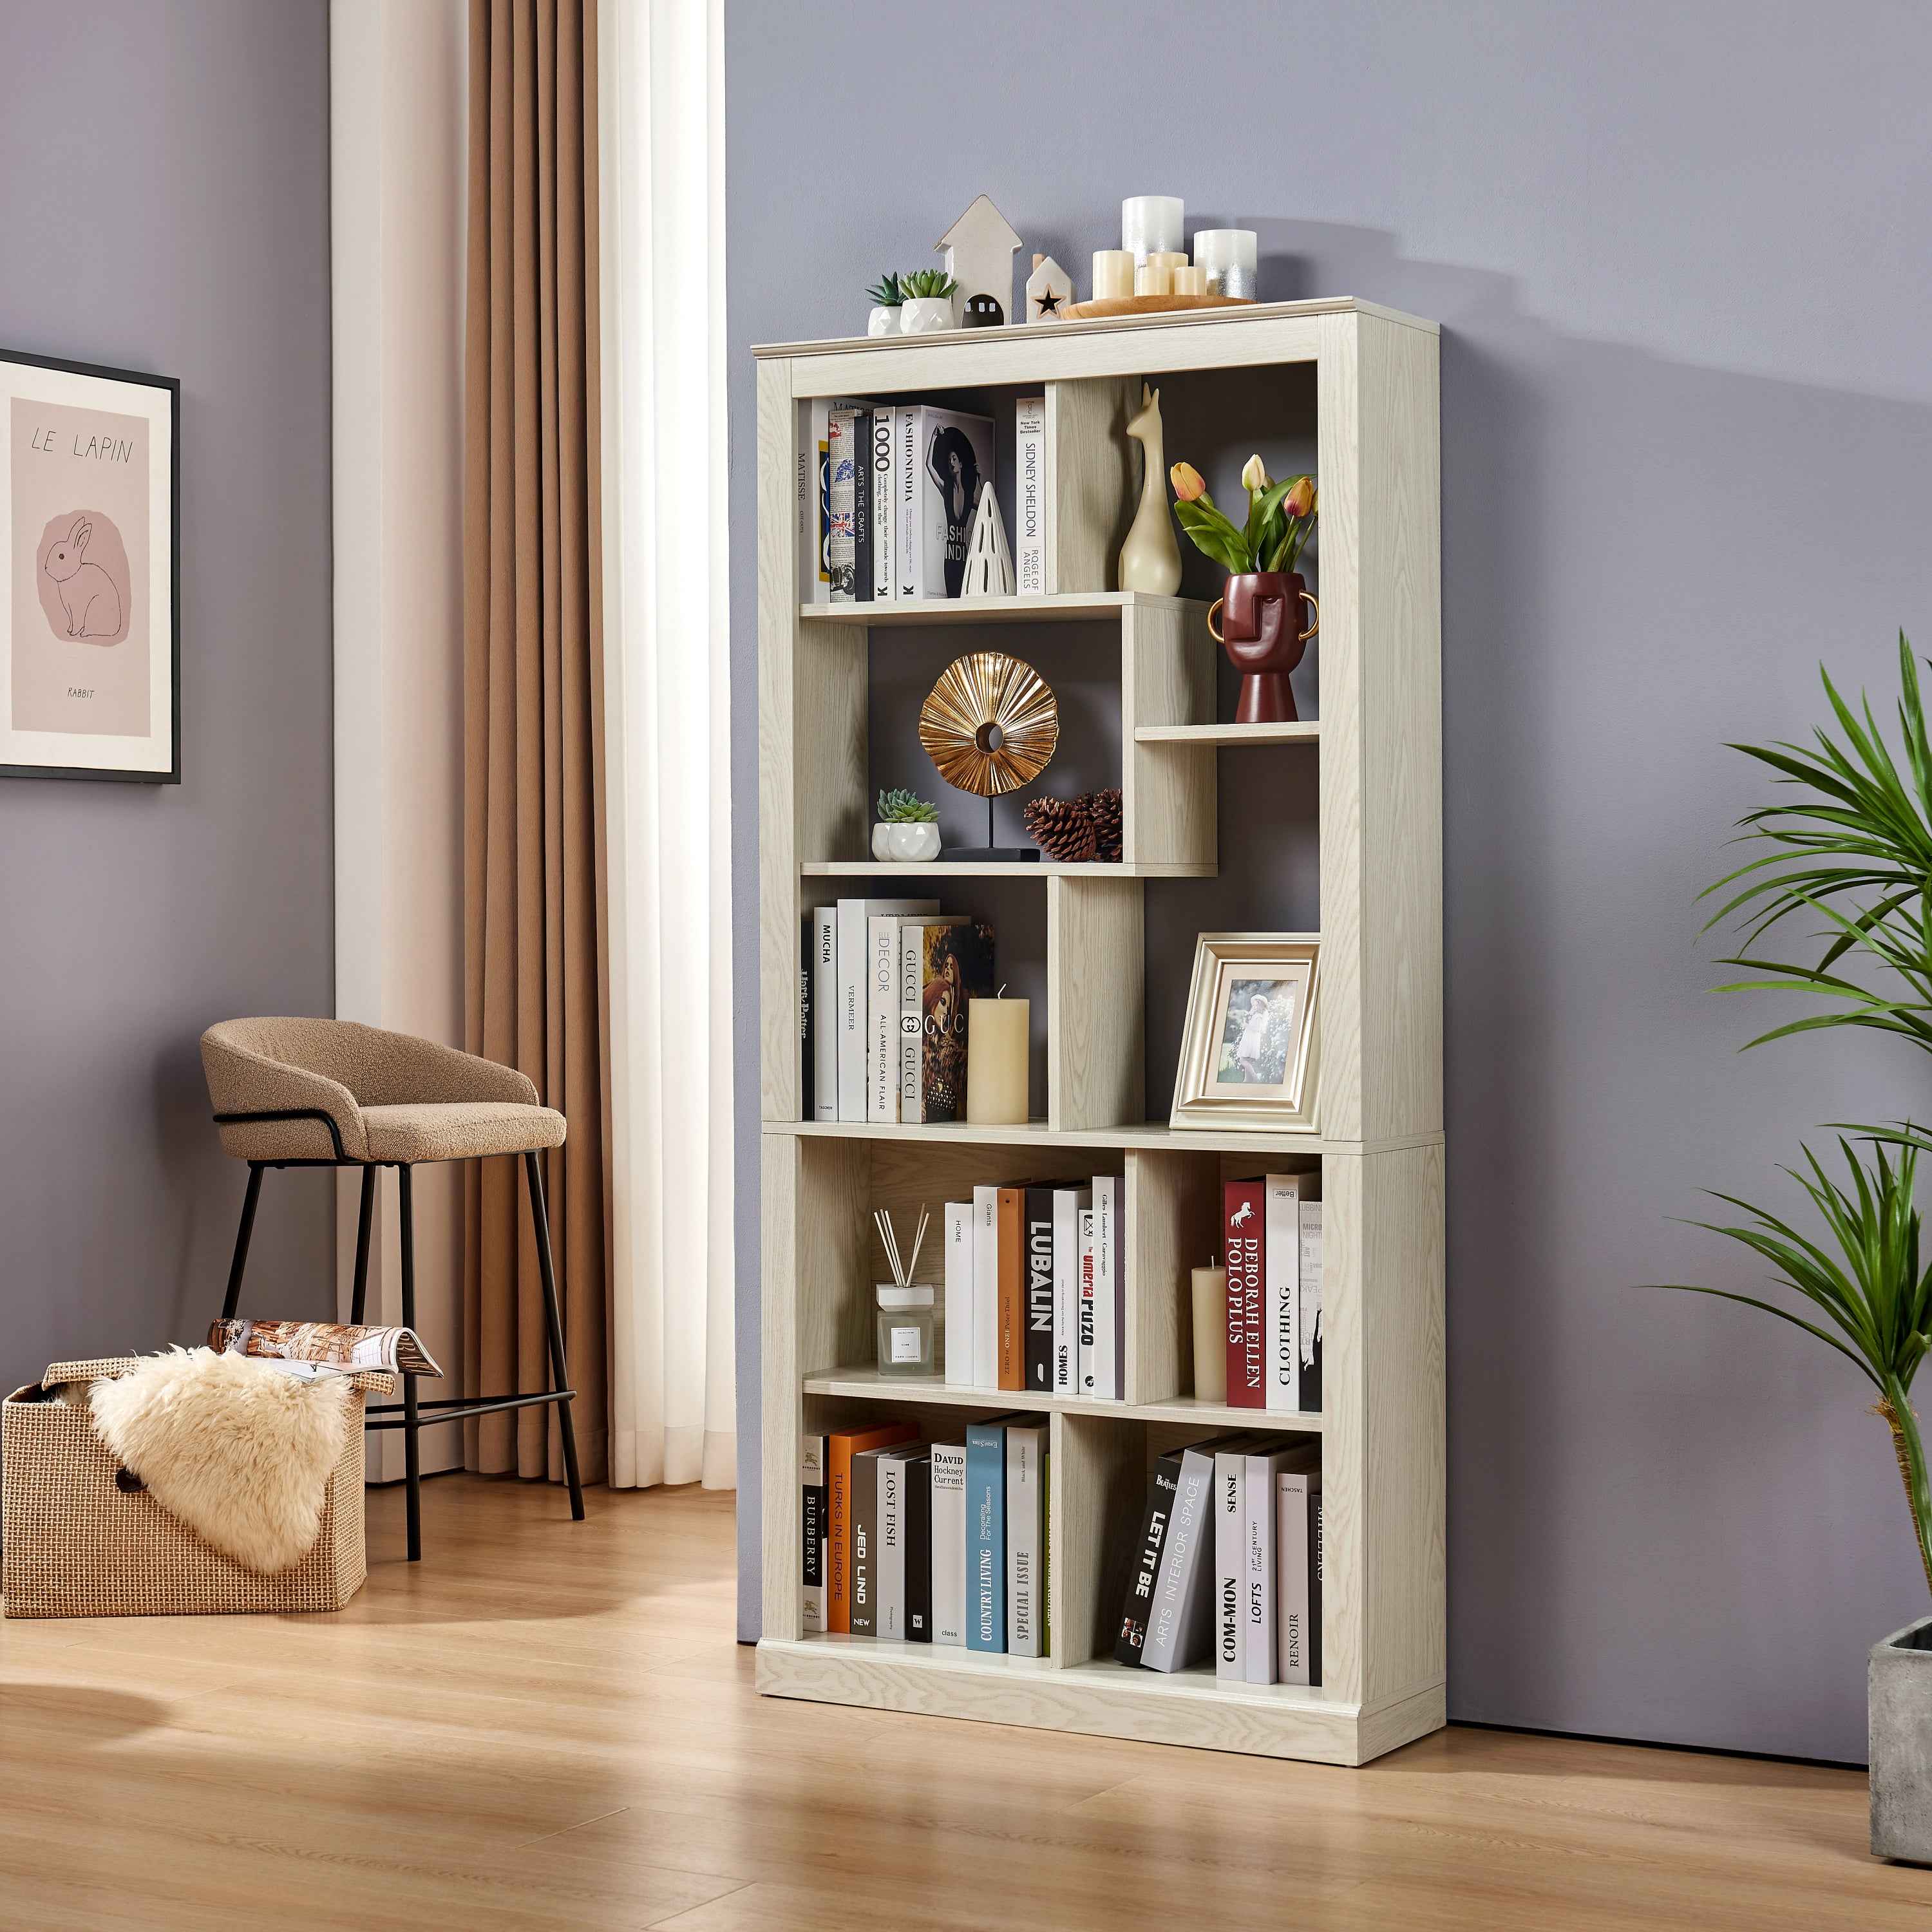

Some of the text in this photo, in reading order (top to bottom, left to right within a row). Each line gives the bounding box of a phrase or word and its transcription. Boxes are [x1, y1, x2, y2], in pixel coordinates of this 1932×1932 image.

[32, 427, 133, 463] LE LAPIN
[875, 415, 890, 472] 1000
[1025, 442, 1036, 537] SIDNEY SHELDON
[945, 544, 968, 562] INDI
[1032, 578, 1039, 591] OF
[67, 687, 95, 699] RABBIT
[878, 938, 889, 992] DECOR
[905, 950, 916, 1003] GUCCI
[905, 1047, 915, 1101] GUCCI
[1030, 1222, 1052, 1331] LUBALIN
[1228, 1238, 1243, 1343] POLO PLUS
[1245, 1238, 1260, 1388] DEBORAH ELLEN
[1279, 1286, 1291, 1386] CLOTHING
[1059, 1345, 1068, 1385] HOMES
[934, 1453, 963, 1465] DAVID
[934, 1465, 963, 1477] Hockney
[934, 1475, 963, 1485] Current
[1156, 1474, 1177, 1491] BEATLES
[887, 1471, 895, 1547] LOST FISH
[1227, 1473, 1236, 1513] SENSE
[807, 1496, 815, 1576] BURBERRY
[835, 1524, 842, 1537] IN
[1135, 1511, 1166, 1598] LET IT BE
[857, 1524, 866, 1604] JED LIND
[1155, 1477, 1200, 1647] ARTS INTERIOR SPACE
[854, 1618, 869, 1626] NEW
[980, 1549, 992, 1641] COUNTRY LIVING
[1017, 1551, 1029, 1640] SPECIAL ISSUE
[1223, 1577, 1236, 1663] COM-MON
[1251, 1582, 1262, 1624] LOFTS
[1289, 1613, 1299, 1668] RENOIR
